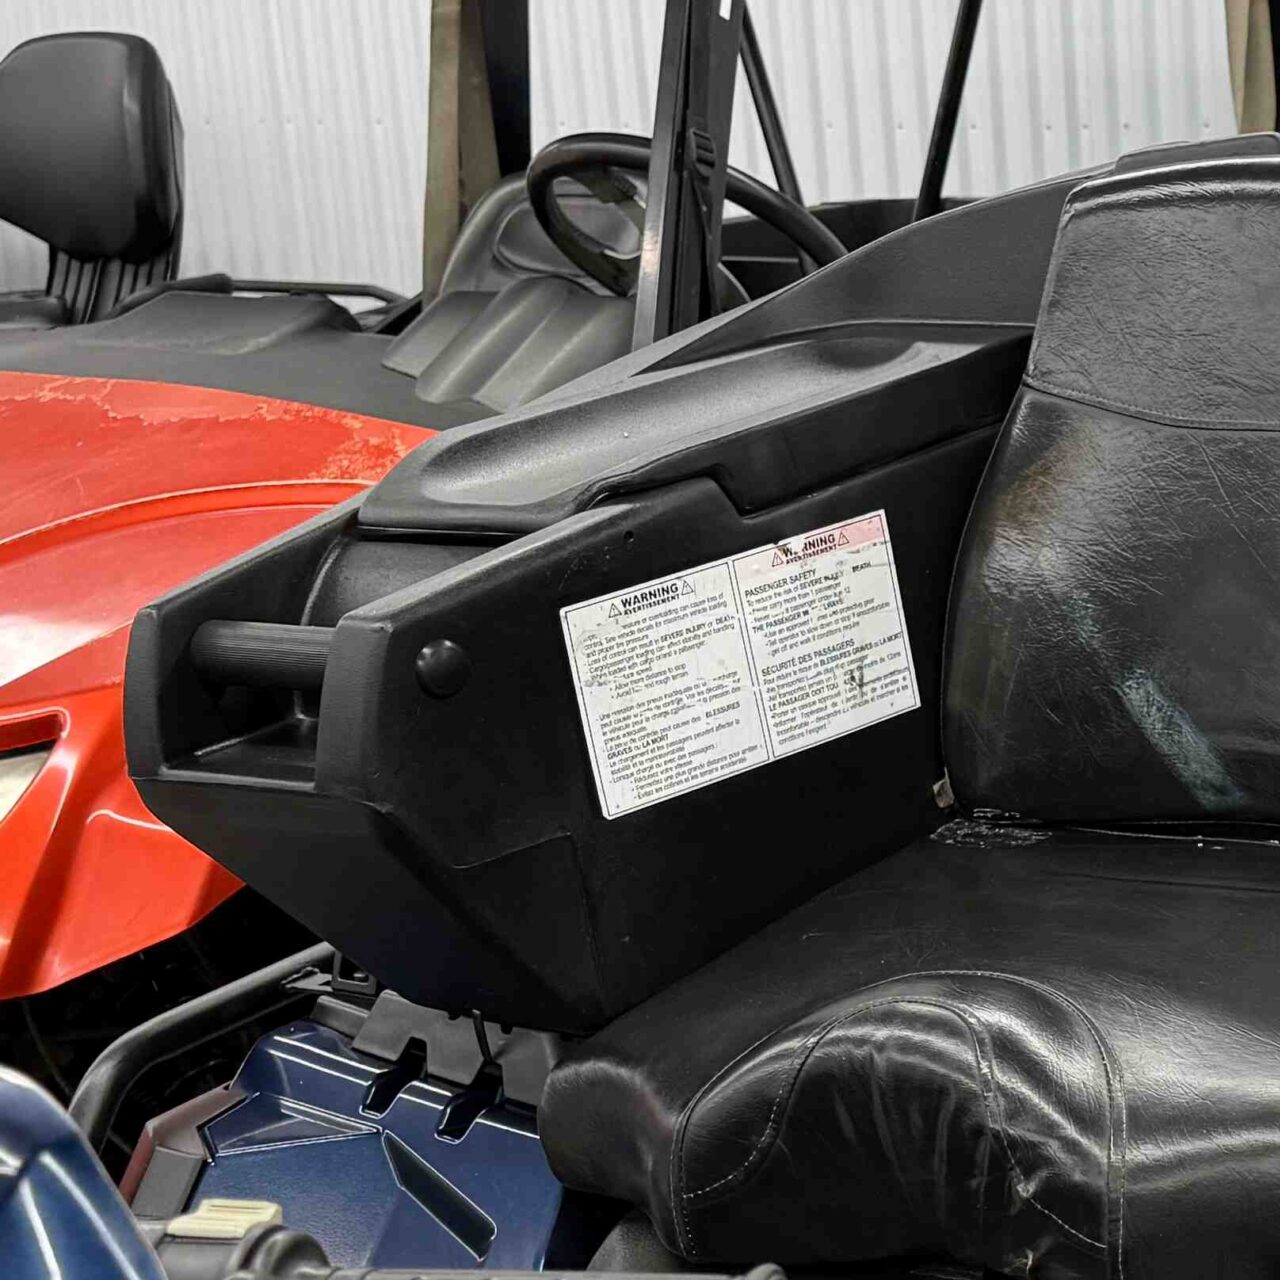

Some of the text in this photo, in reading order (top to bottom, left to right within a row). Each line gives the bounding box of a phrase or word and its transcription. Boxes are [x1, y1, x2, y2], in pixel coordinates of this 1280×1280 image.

[782, 533, 835, 557] WRNING
[620, 582, 678, 608] WARNING
[744, 577, 788, 598] PASSENGER
[789, 568, 816, 584] SAFETY
[623, 593, 679, 615] AVERTISSEMENT
[765, 611, 801, 628] PASSENGER
[761, 656, 797, 677] SÉCURITÉ
[813, 638, 855, 658] PASSAGERS
